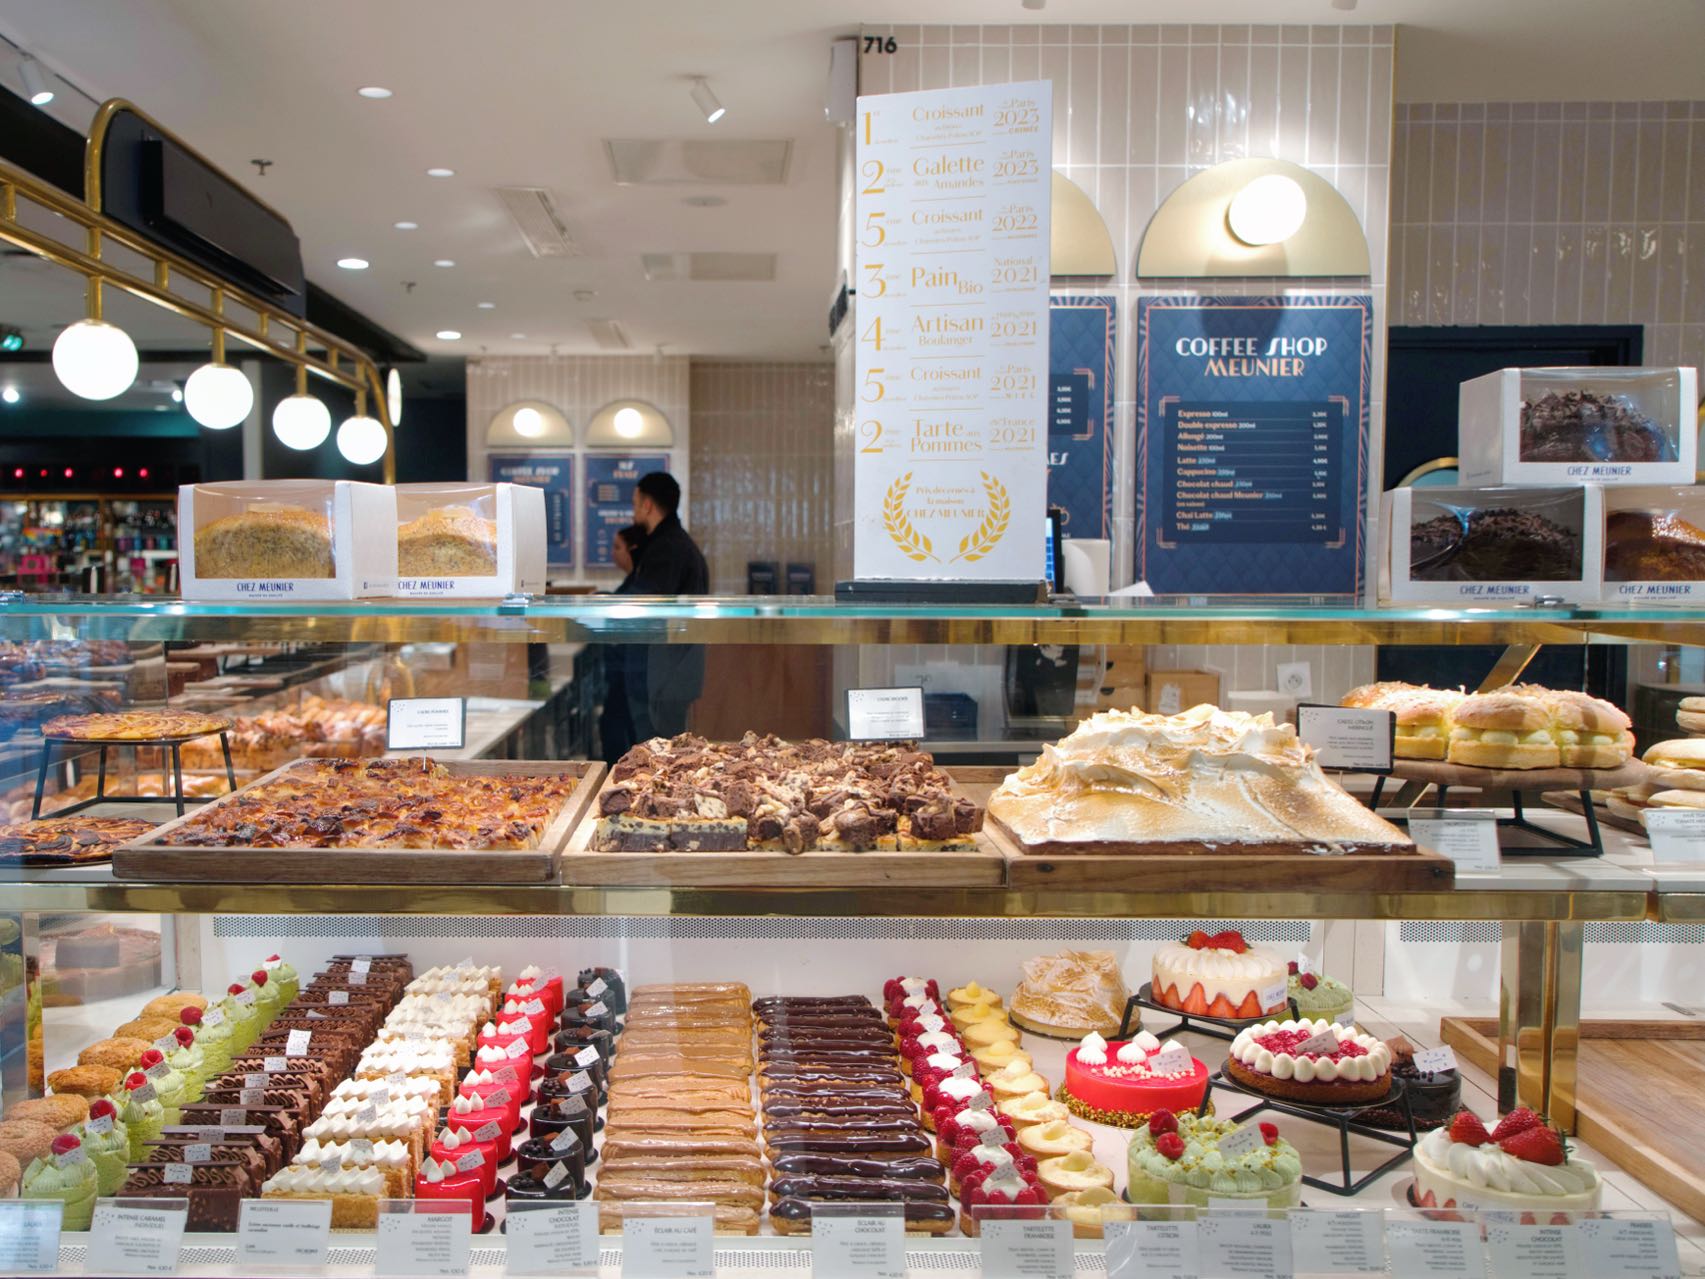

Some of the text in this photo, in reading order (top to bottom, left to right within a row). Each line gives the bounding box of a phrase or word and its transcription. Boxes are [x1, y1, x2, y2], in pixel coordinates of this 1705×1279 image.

[863, 36, 898, 54] 716
[912, 104, 984, 122] Croissant
[993, 107, 1040, 127] 2023
[862, 155, 1040, 194] 2 Galette 2023
[862, 208, 1039, 248] 5 Croissant 2022
[862, 264, 1038, 299] 3 Pain 2021
[958, 281, 984, 295] Bio
[861, 313, 1037, 351] 4 Artisan 2021
[1175, 337, 1329, 357] COFFEE SHOP
[1204, 358, 1305, 377] MEUNIER
[861, 367, 1037, 403] 5 Croissant 2021
[1178, 421, 1204, 430] Double
[861, 419, 884, 454] 2
[912, 419, 964, 438] Tarte
[990, 427, 1036, 444] 2021
[911, 437, 983, 453] Pommes
[1177, 456, 1197, 465] Latte
[1567, 466, 1632, 477] CHEZ MEUNIER
[1176, 479, 1210, 488] Chocolat
[1210, 480, 1234, 488] chaud
[1176, 491, 1210, 499] Chocolat
[1210, 491, 1233, 499] chaud
[1194, 512, 1213, 520] Latte
[237, 582, 294, 592] CHEZ MEUNIER
[398, 580, 456, 590] CHEZ MEUNIER
[1459, 585, 1530, 595] CHEZ MEUNIER
[1618, 585, 1692, 595] CHEZ MEUNIER
